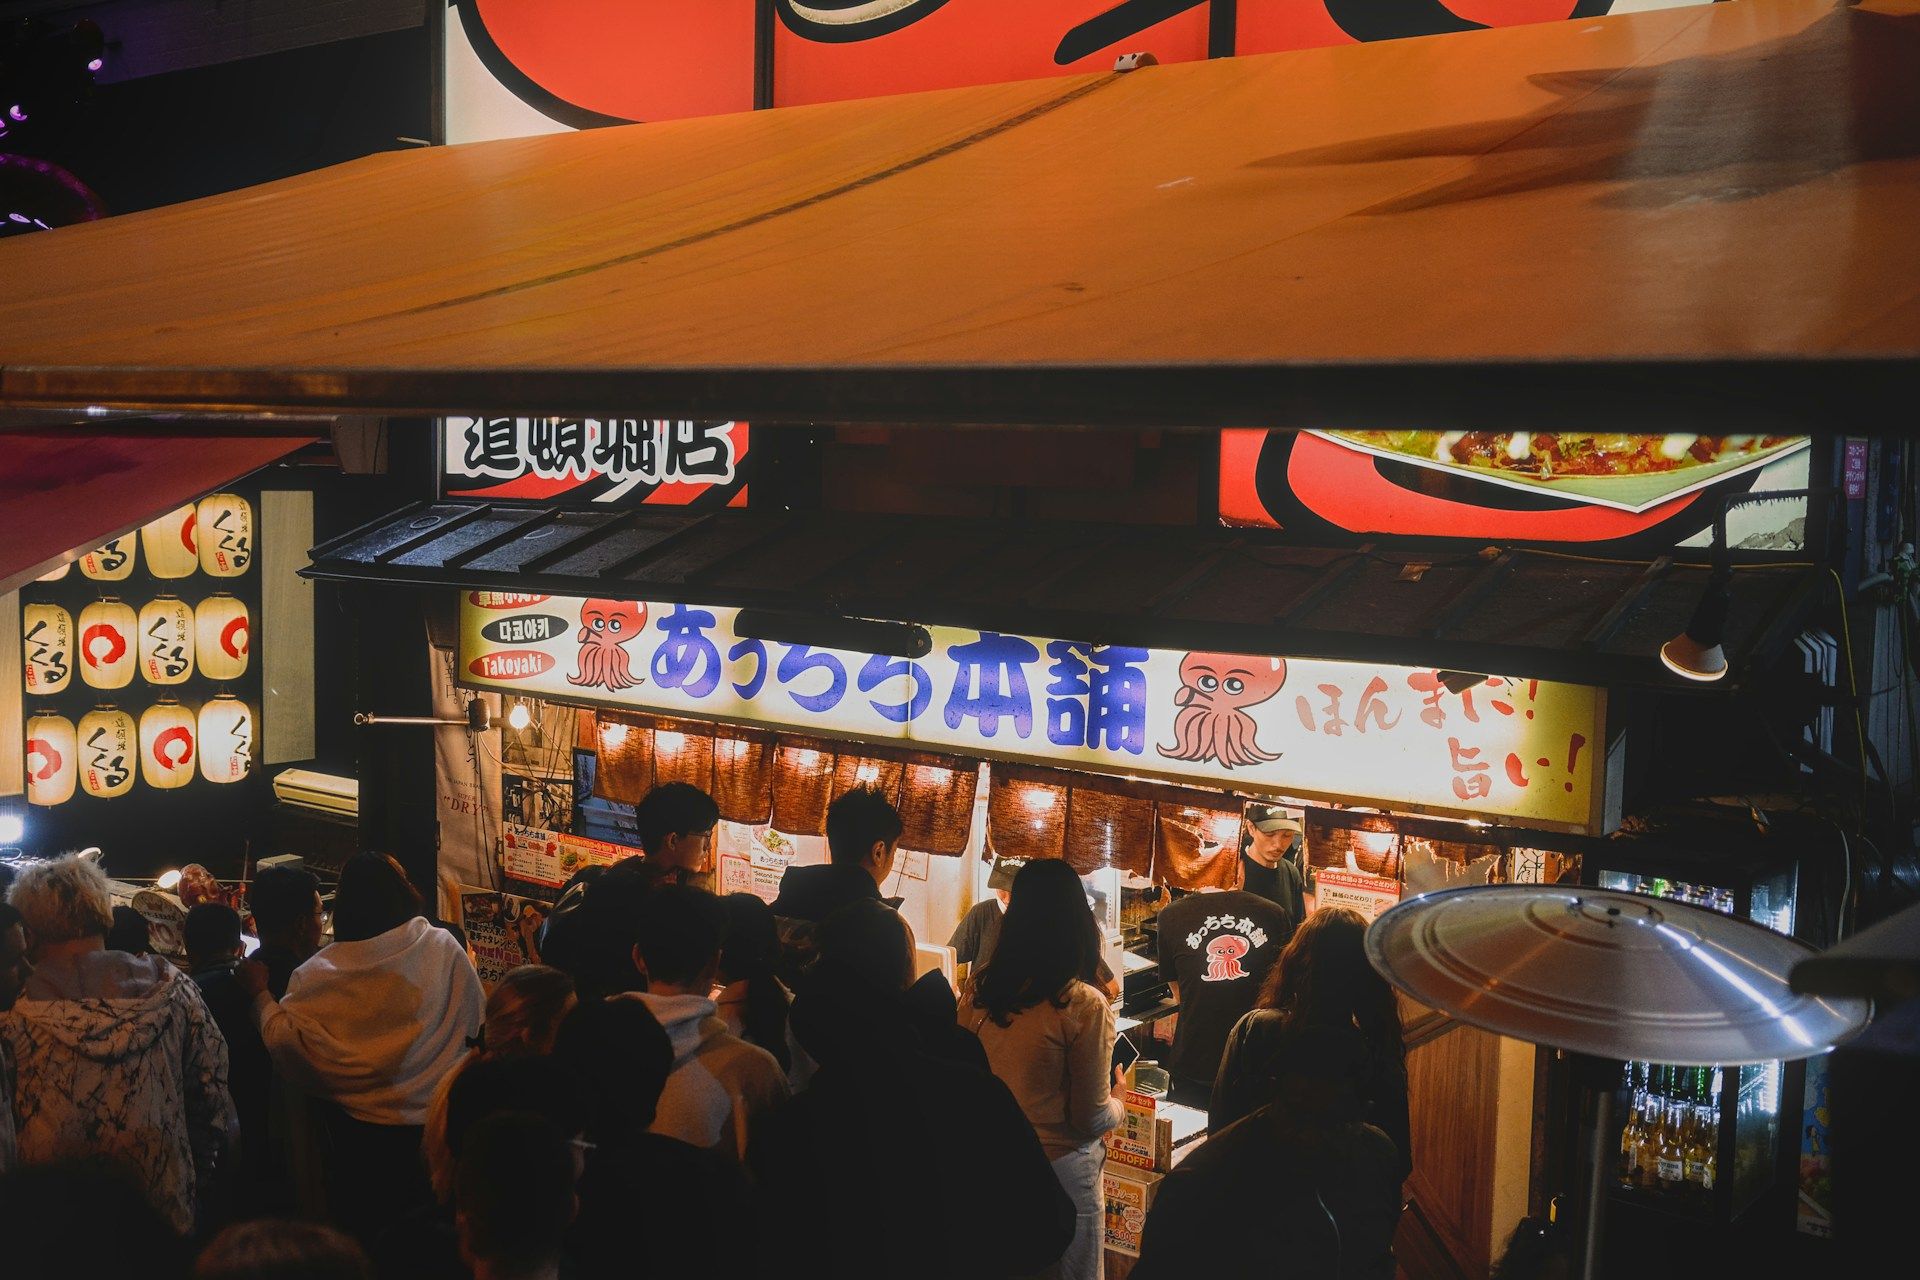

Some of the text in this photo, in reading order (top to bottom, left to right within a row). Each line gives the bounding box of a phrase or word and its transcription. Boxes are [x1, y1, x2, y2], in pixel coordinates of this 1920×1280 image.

[213, 509, 251, 568] くくる
[25, 620, 69, 683] くくる
[148, 616, 189, 678] くくる
[499, 617, 550, 641] 다코야키
[482, 653, 542, 676] Takoyaki
[87, 727, 130, 788] くくる
[1448, 733, 1585, 800] 旨い!
[1185, 913, 1269, 950] あっちち本舗
